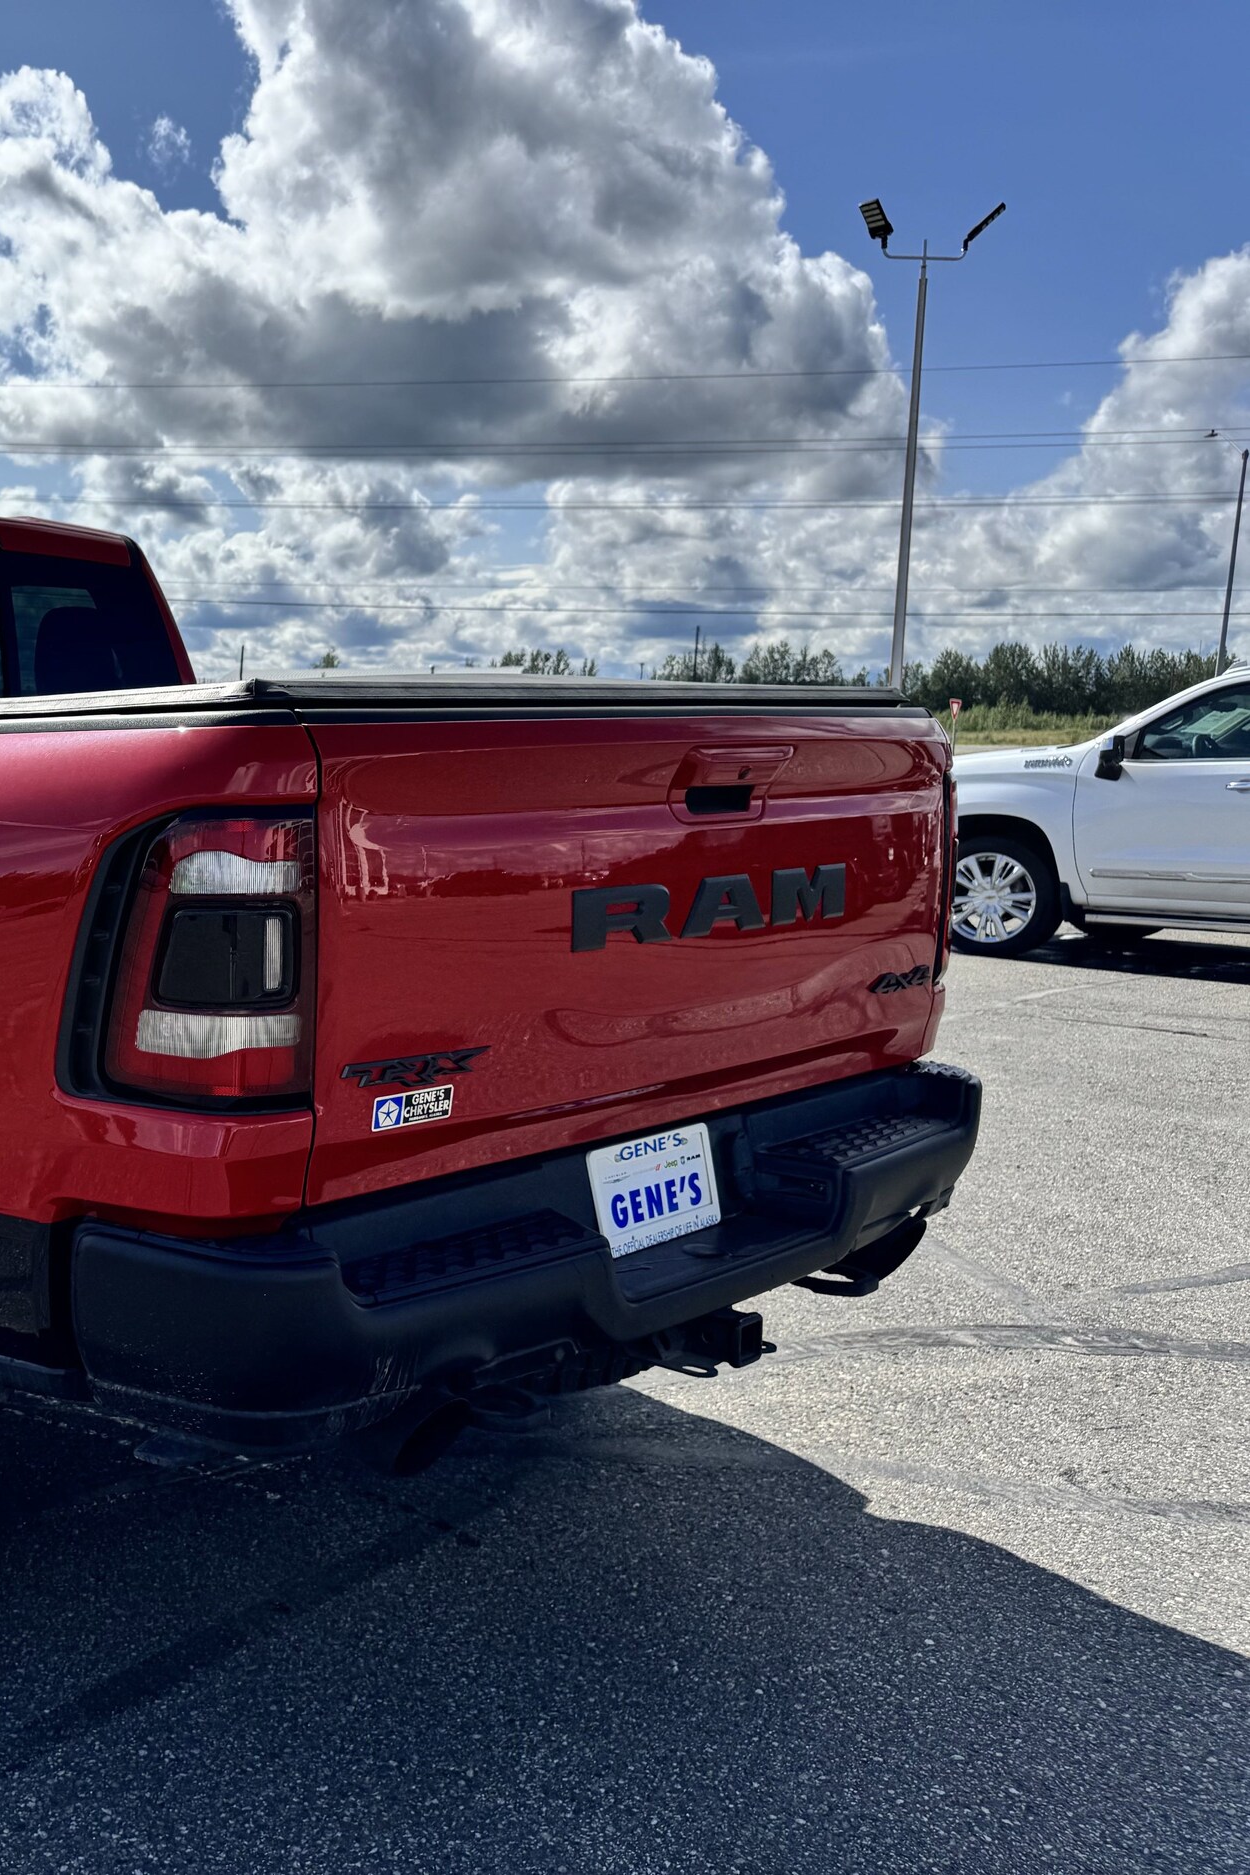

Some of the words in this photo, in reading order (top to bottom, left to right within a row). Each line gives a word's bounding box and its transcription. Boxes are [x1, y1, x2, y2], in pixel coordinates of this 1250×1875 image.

[571, 862, 846, 953] RAM
[340, 1045, 492, 1088] TRX
[404, 1099, 450, 1118] CHRYSLER
[412, 1089, 445, 1105] GENE'S
[619, 1132, 682, 1161] GENE'S
[686, 1153, 701, 1161] RAM
[663, 1158, 678, 1169] Jeep
[611, 1172, 702, 1228] GENE'S
[611, 1245, 623, 1257] THE
[622, 1237, 646, 1253] OFFICIAL
[645, 1227, 674, 1246] DEALERSHIP
[674, 1225, 683, 1236] OF
[683, 1221, 693, 1234] LIFE
[700, 1214, 718, 1226] ALASKA
